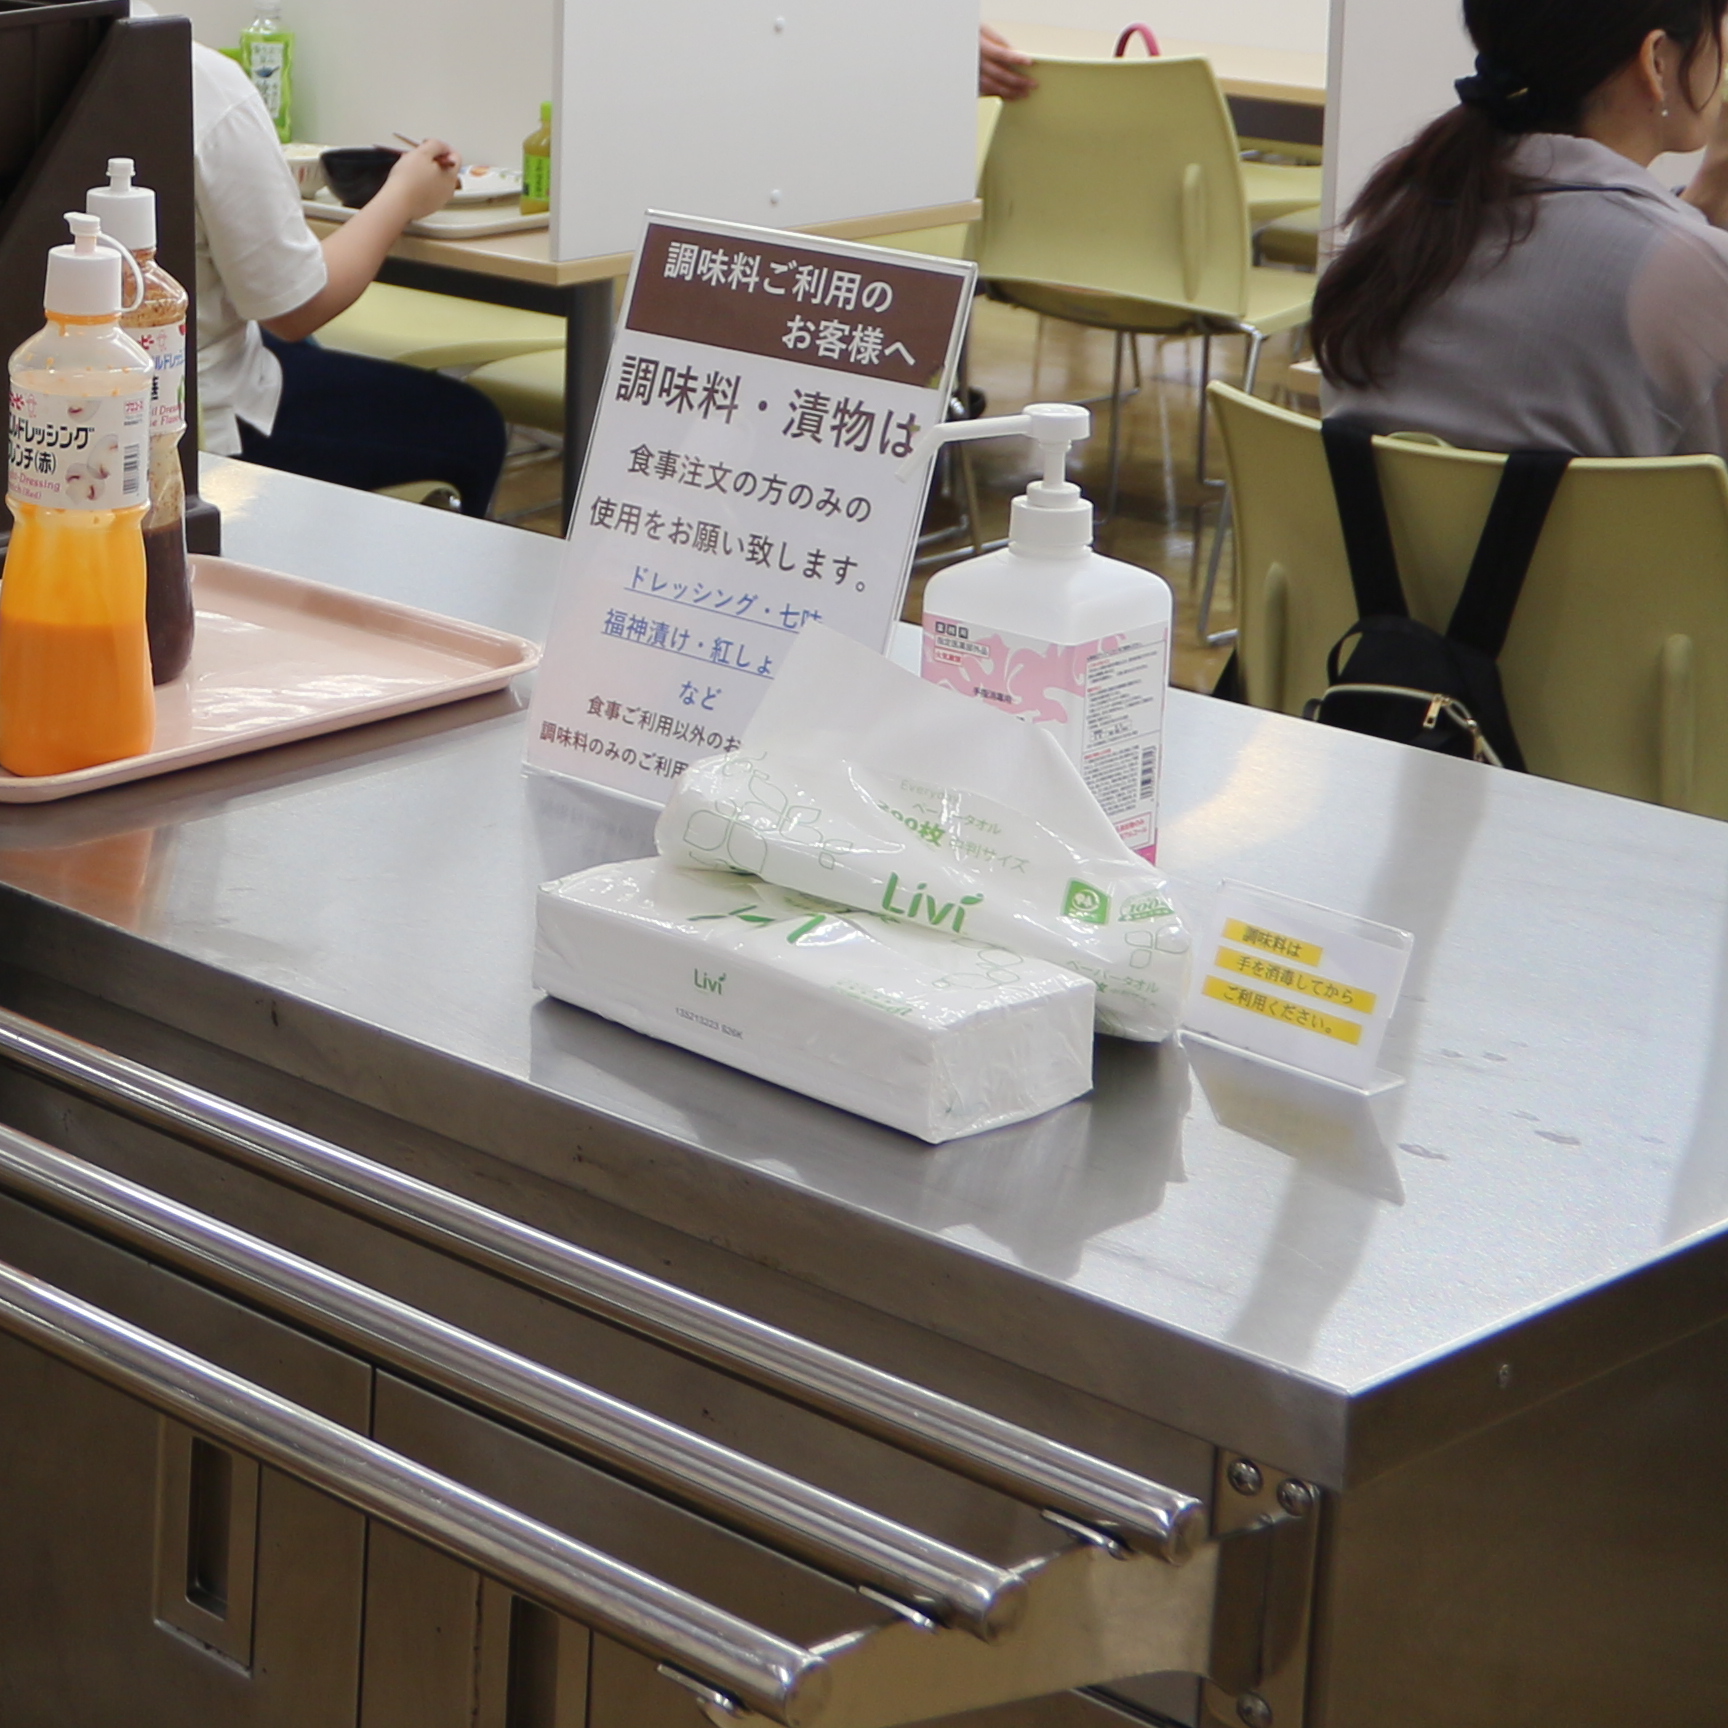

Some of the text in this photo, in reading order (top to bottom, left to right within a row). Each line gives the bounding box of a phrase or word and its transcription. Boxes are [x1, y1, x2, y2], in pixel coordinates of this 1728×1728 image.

[663, 241, 893, 313] 調味料ご利用の
[782, 314, 916, 366] お客様へ
[615, 355, 919, 459] 調味料・漬物は
[8, 440, 57, 475] レンチ(赤)
[627, 443, 872, 523] 食事注文の方のみの
[589, 495, 866, 593] 使用をお願い致します。
[603, 607, 773, 675] 福神漬け・紅しょ
[678, 680, 723, 712] など
[912, 802, 1002, 834] ペーータオル
[881, 872, 984, 933] Livi
[1242, 925, 1303, 958] 調味料は
[694, 968, 727, 995] Livi
[1236, 956, 1354, 1005] 手を消毒してから
[1223, 984, 1332, 1035] ご利用ください。
